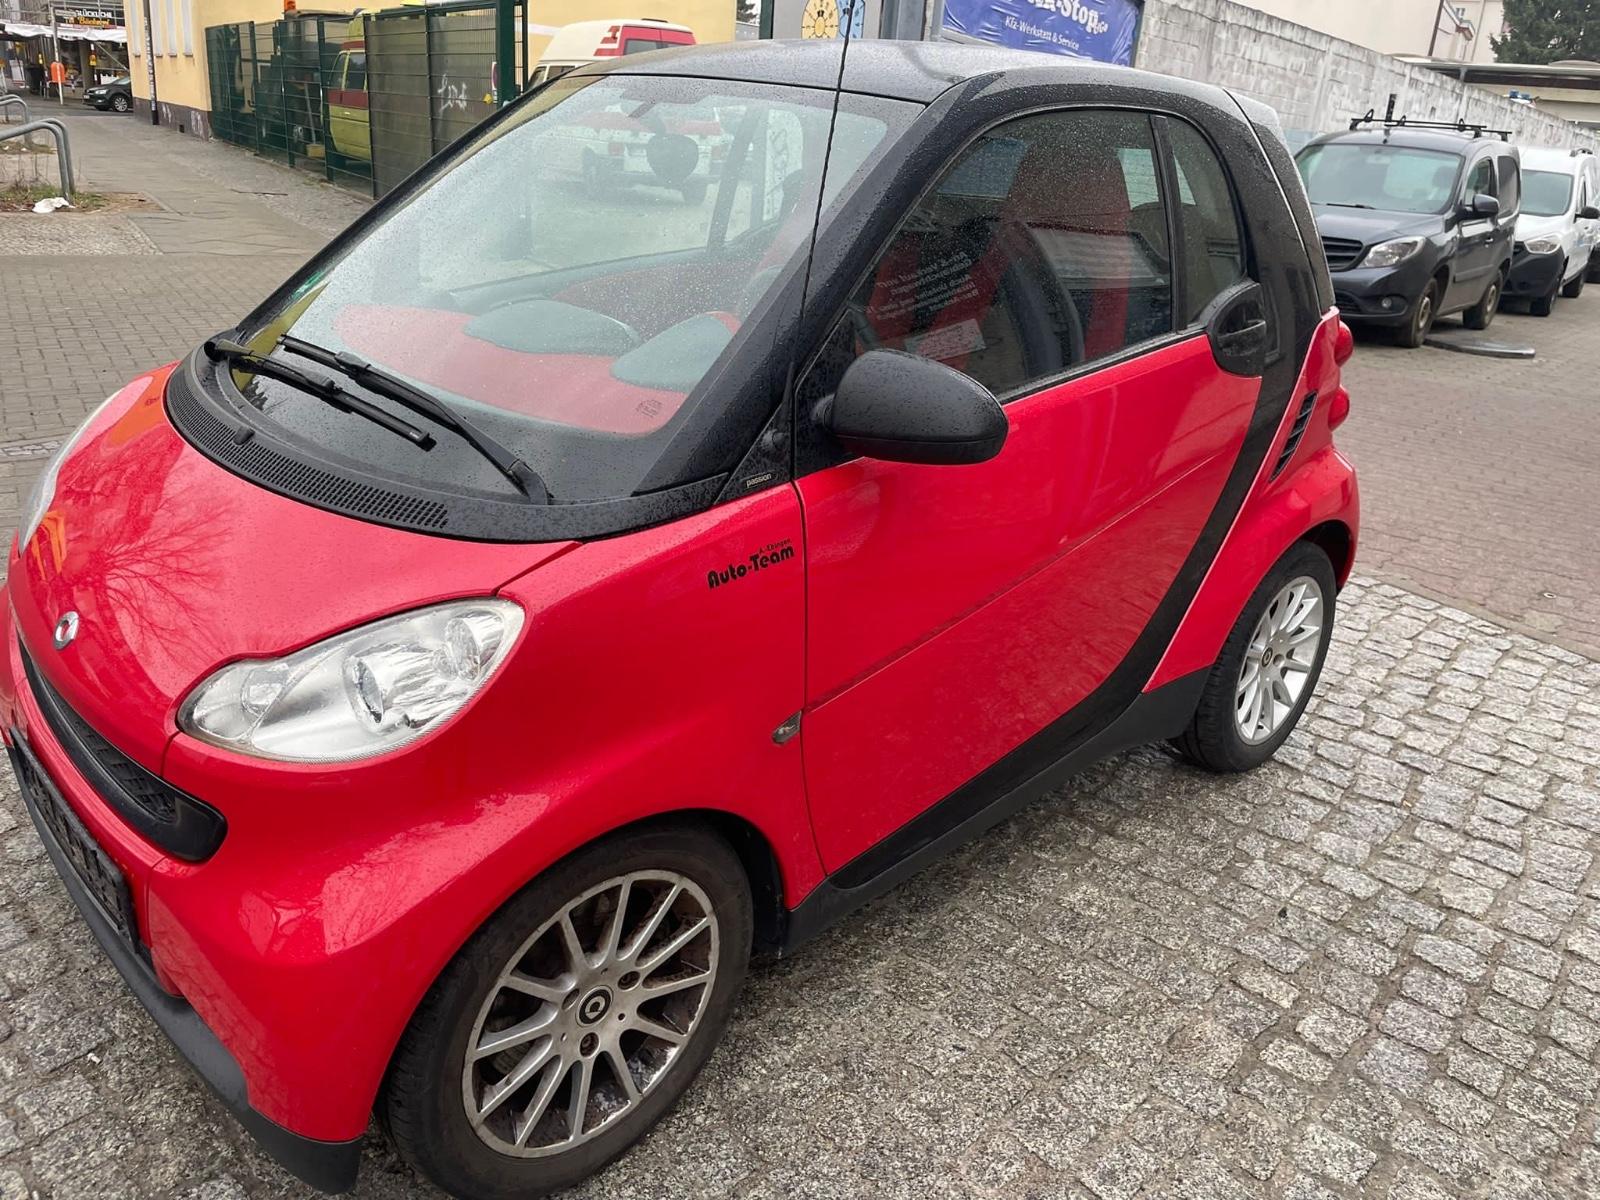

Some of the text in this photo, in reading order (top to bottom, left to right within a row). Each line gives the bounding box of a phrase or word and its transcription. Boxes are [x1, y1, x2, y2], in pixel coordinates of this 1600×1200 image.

[1058, 34, 1079, 50] Service
[746, 473, 772, 488] passion
[707, 545, 795, 590] Auto-Team
